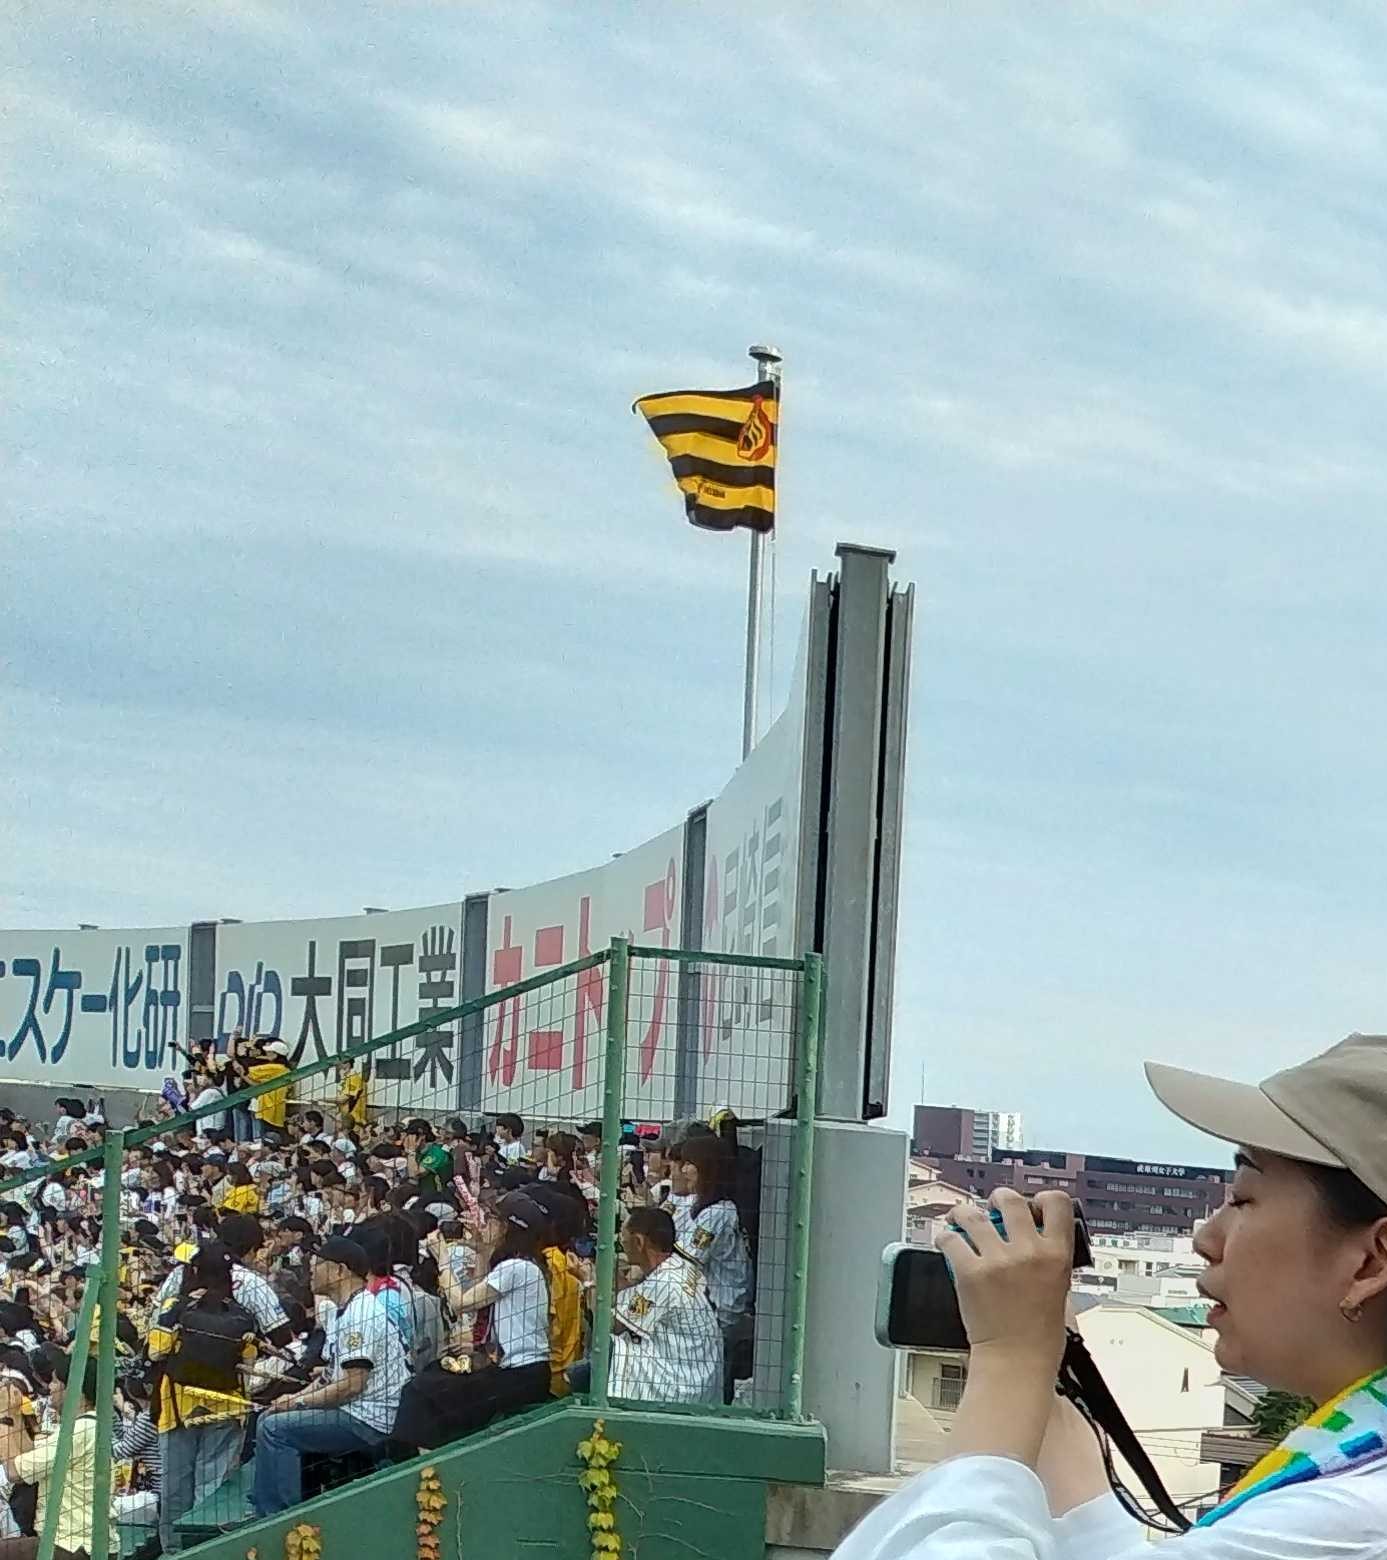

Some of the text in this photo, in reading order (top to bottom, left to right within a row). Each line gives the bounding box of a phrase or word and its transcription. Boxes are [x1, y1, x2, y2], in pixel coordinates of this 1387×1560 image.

[0, 944, 182, 1071] スケー化研
[290, 924, 458, 1088] 大同工業
[489, 857, 677, 1091] カニトプ
